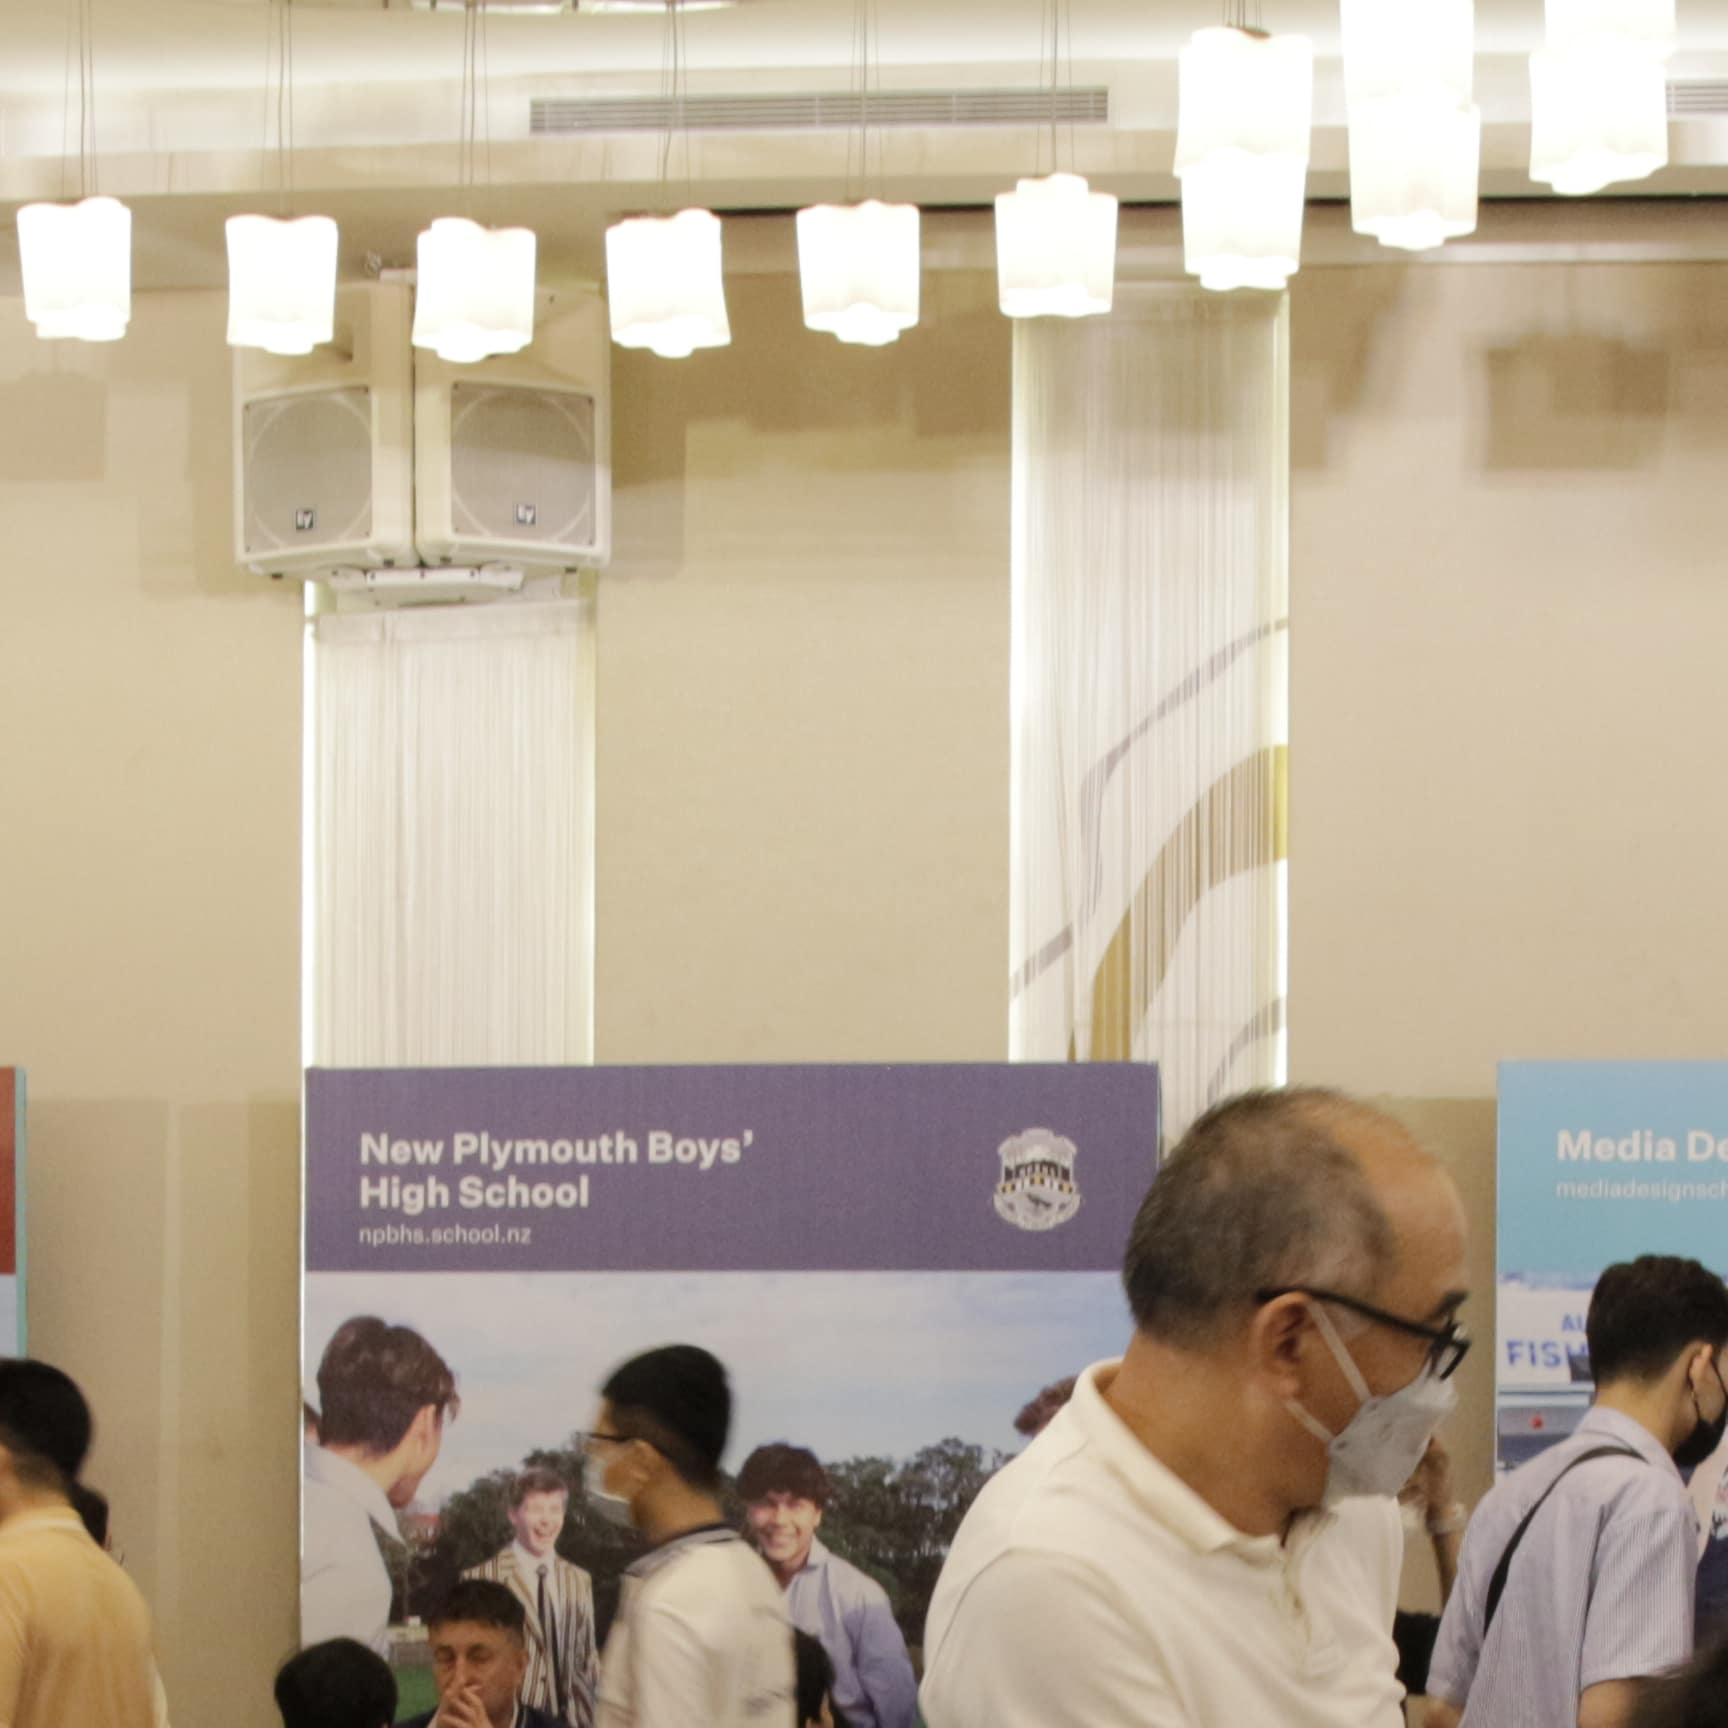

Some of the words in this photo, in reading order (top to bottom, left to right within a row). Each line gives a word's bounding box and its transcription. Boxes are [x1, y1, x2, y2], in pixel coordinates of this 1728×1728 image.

[359, 1132, 444, 1165] New
[453, 1131, 638, 1171] Plymouth
[648, 1129, 754, 1170] Boys'
[1556, 1129, 1676, 1162] Media
[359, 1175, 449, 1215] High
[458, 1174, 590, 1209] School
[359, 1223, 532, 1247] npbhs.school.nz
